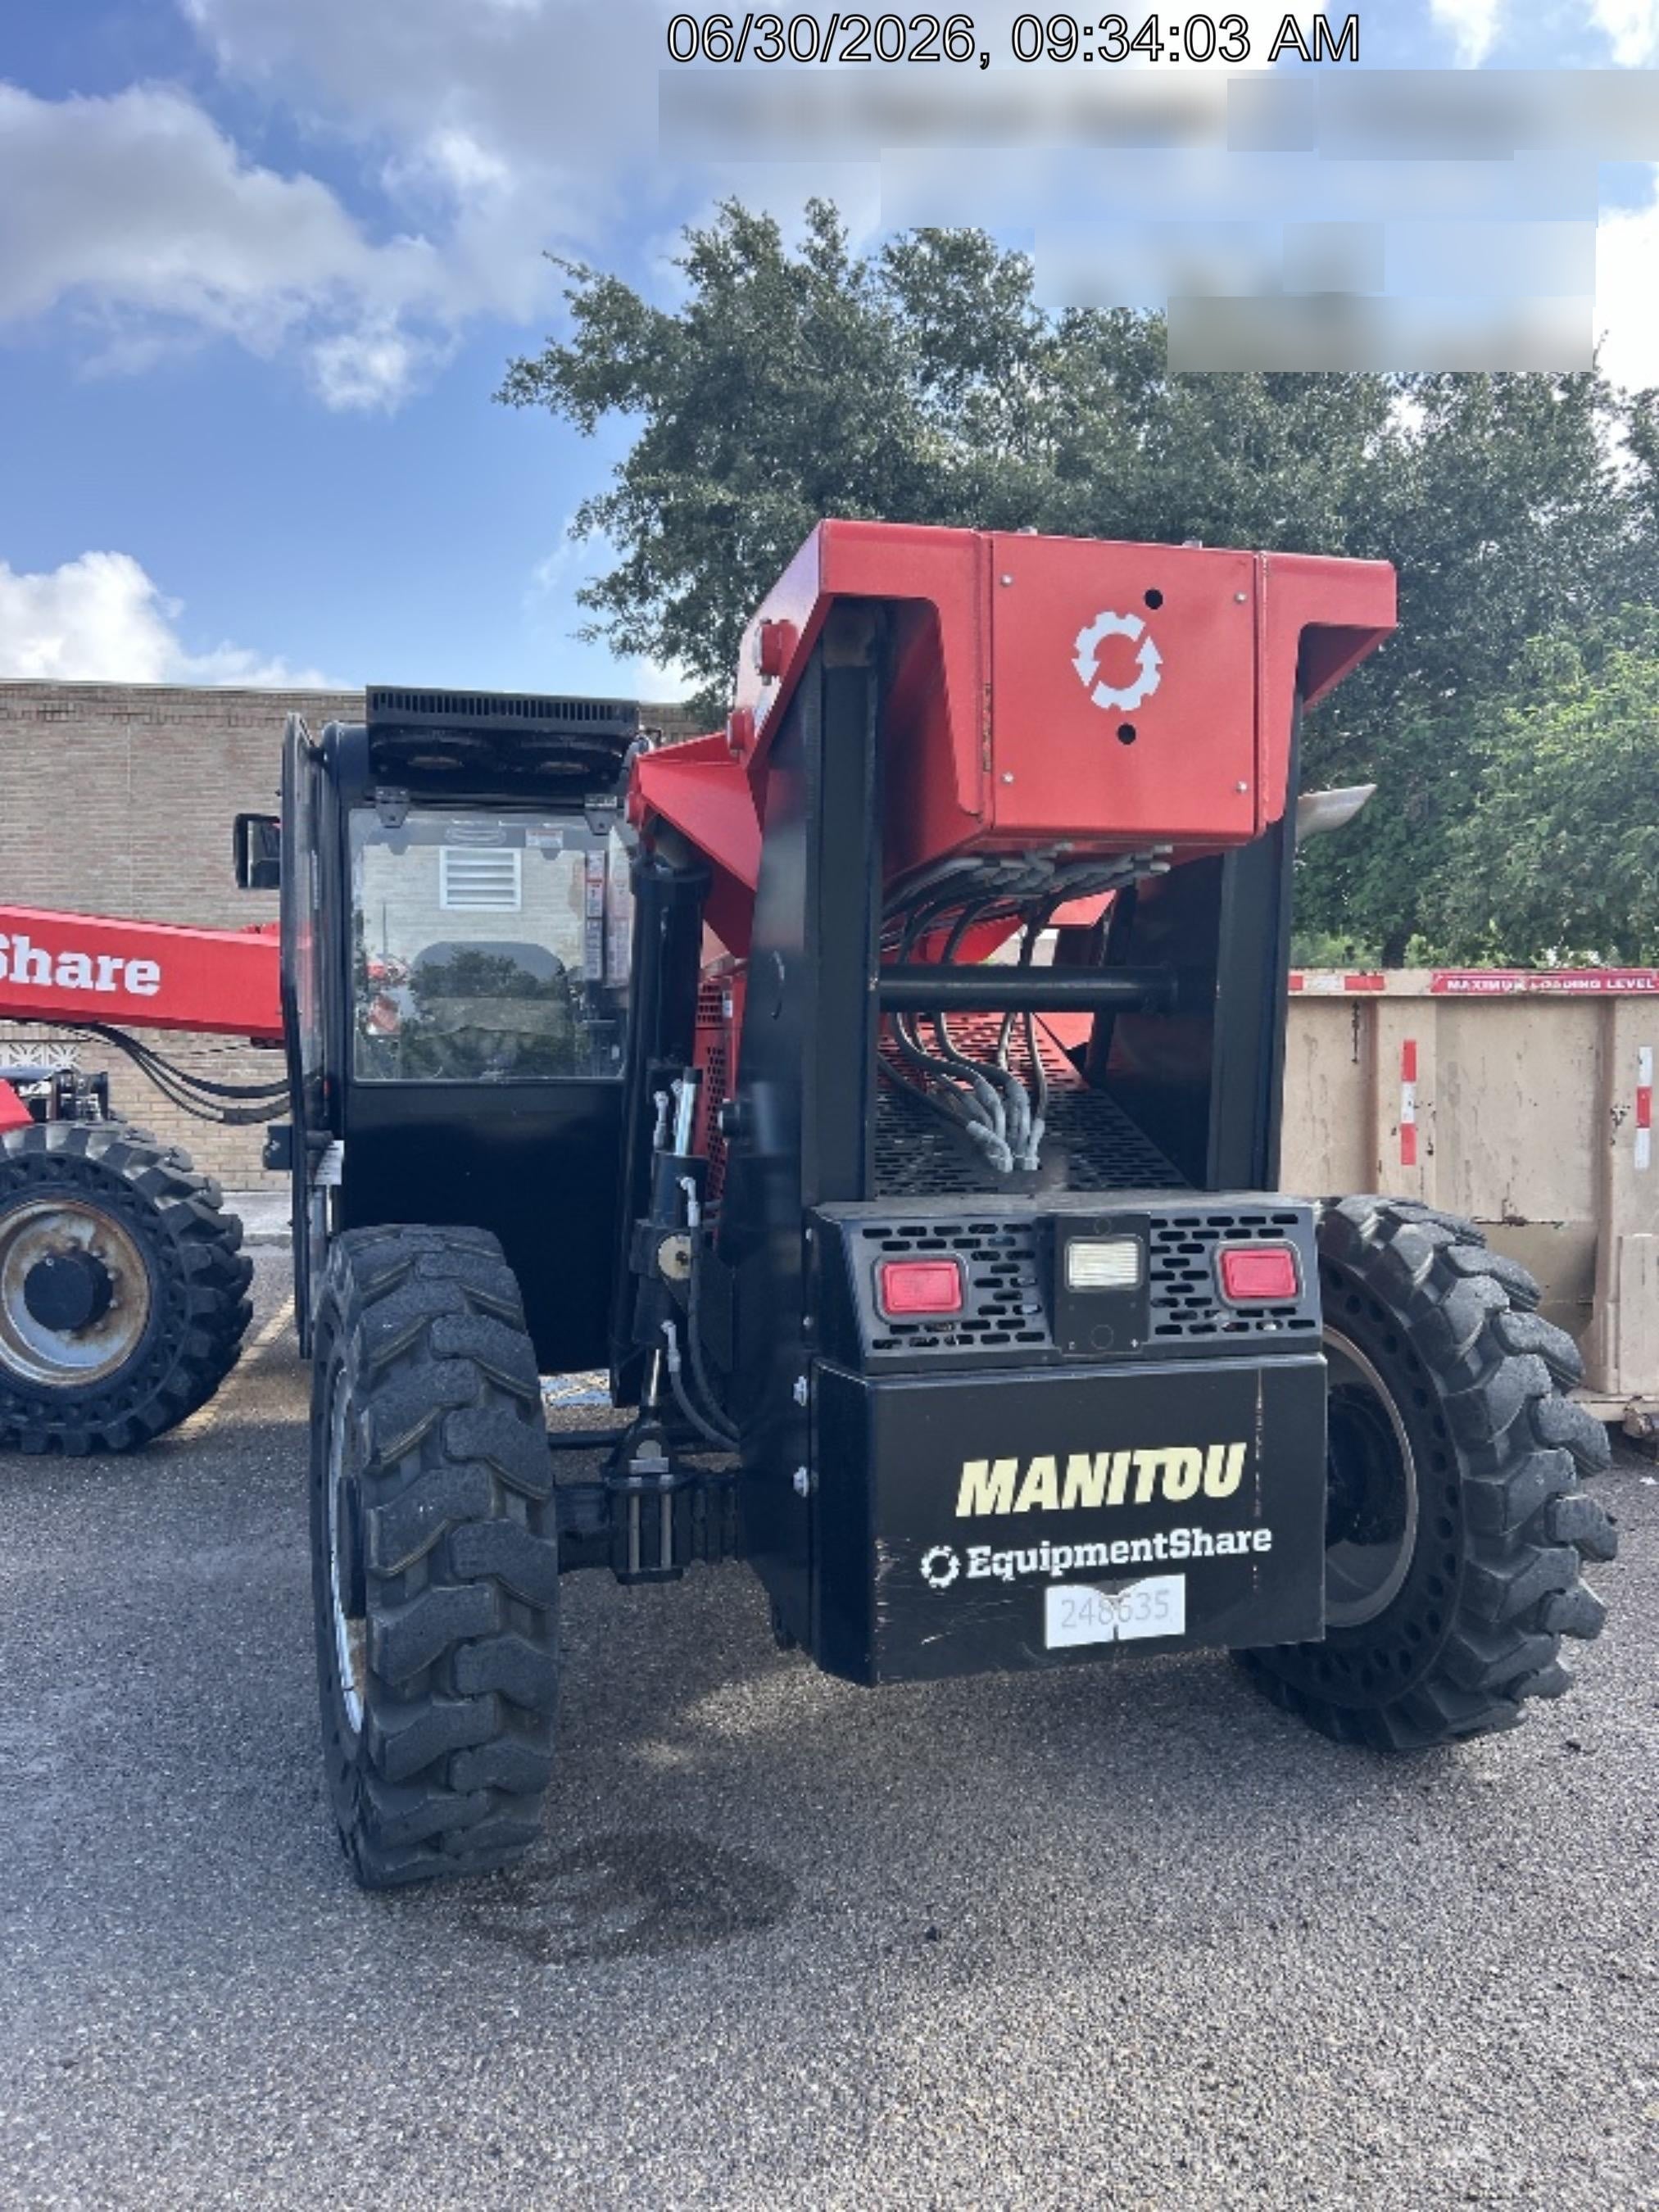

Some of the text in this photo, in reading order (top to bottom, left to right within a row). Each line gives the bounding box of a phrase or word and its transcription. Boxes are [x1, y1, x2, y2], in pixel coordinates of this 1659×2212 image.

[1607, 977, 1655, 990] LEVEL
[954, 1443, 1247, 1517] MANITOU
[965, 1527, 1272, 1582] EquipmentShare
[1061, 1589, 1170, 1628] 248635
